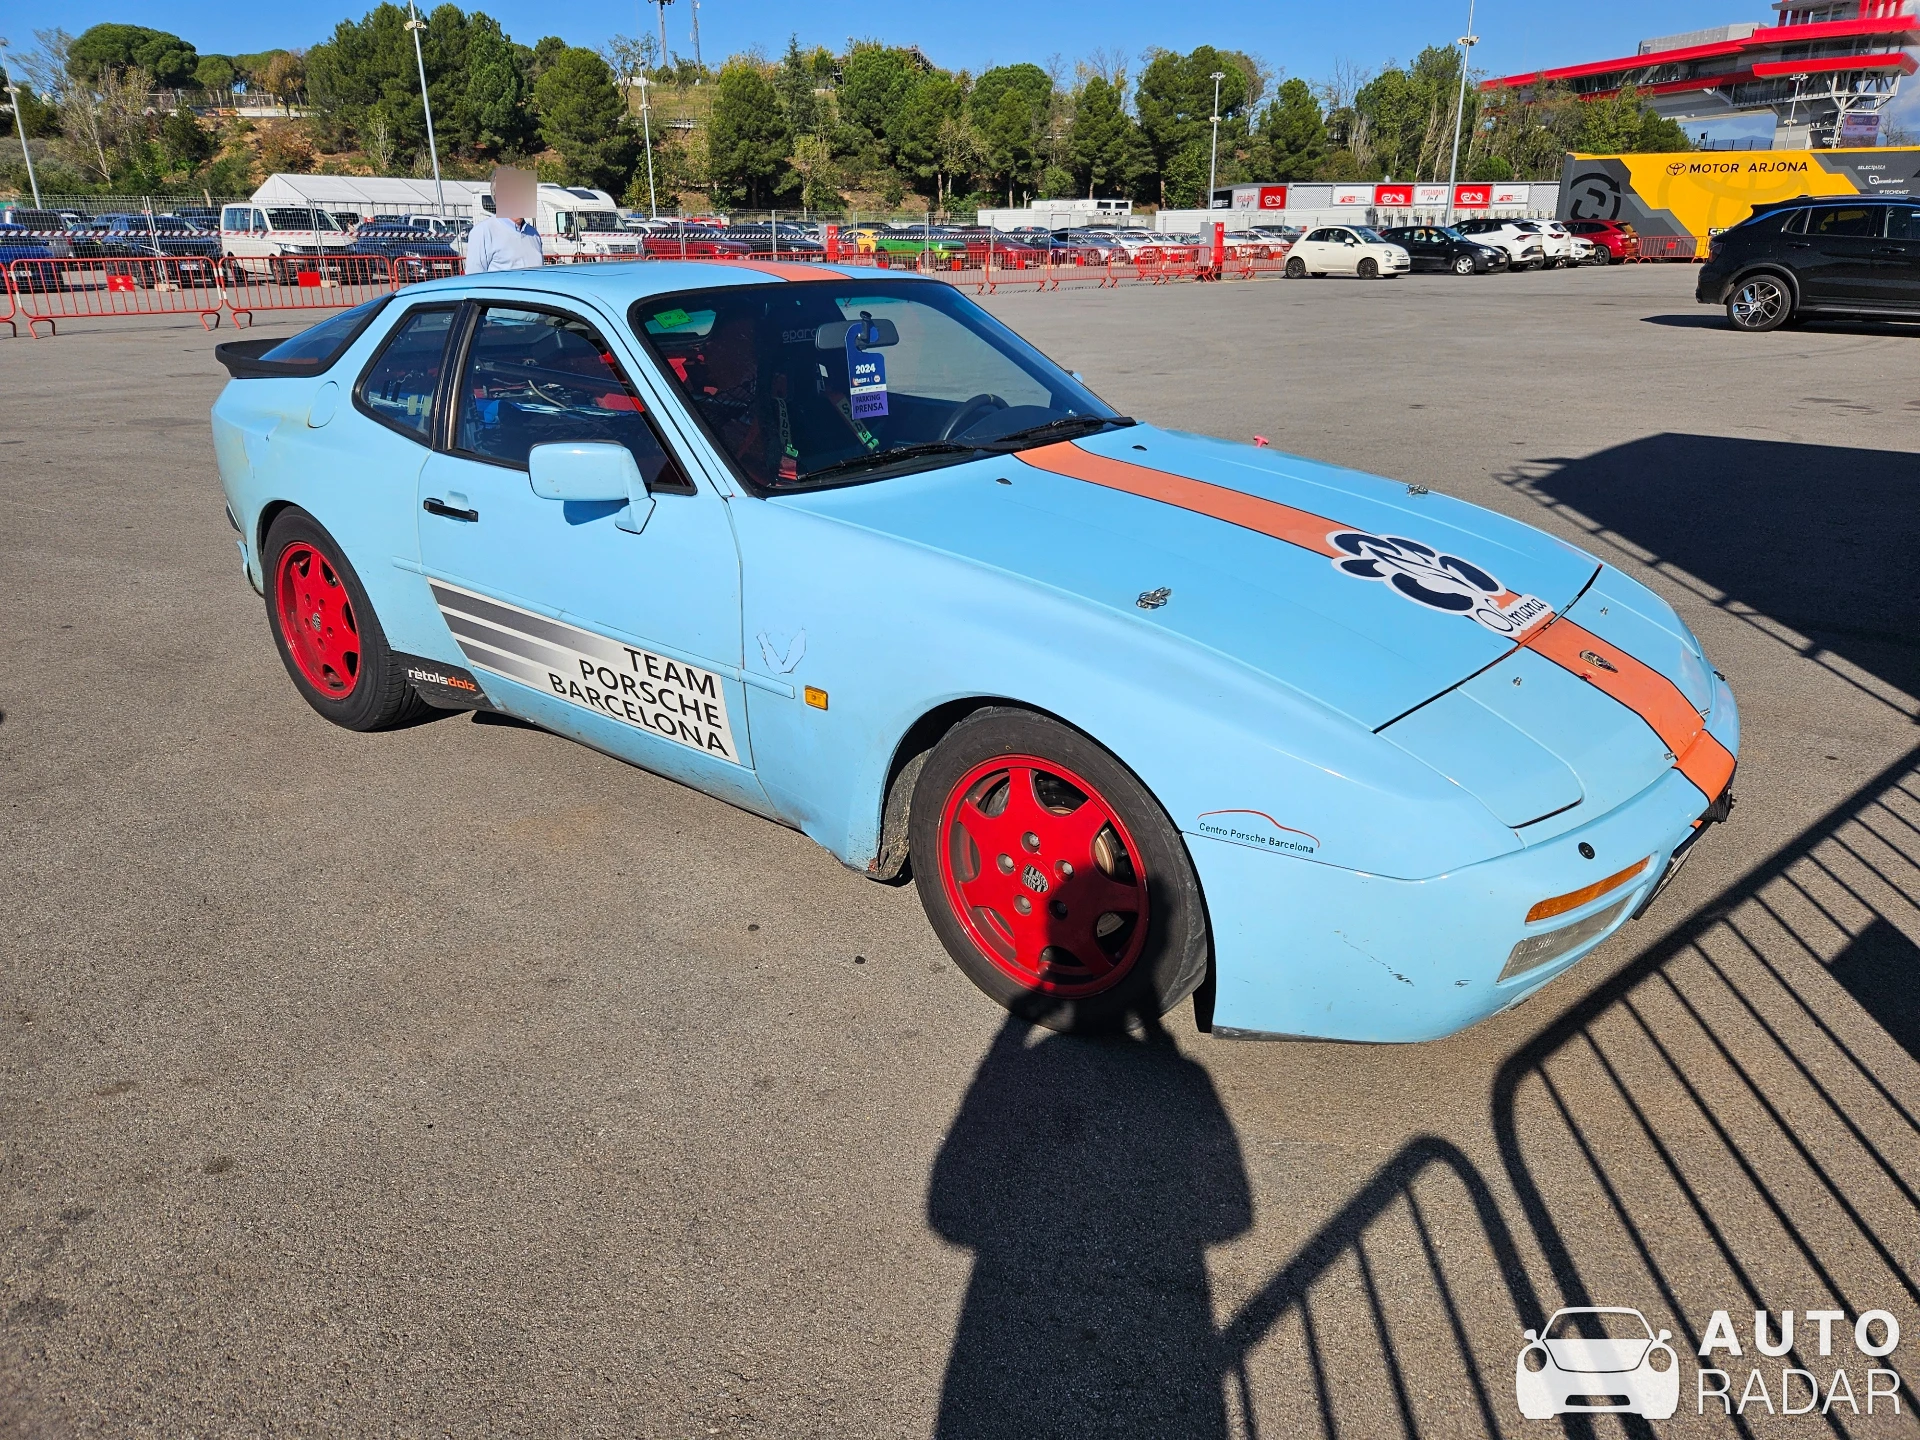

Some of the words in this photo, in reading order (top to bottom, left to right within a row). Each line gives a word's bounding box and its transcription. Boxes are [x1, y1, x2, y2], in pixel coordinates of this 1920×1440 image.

[1689, 163, 1740, 174] MOTOR
[1748, 161, 1809, 173] ARJONA
[855, 363, 876, 375] 2024
[855, 393, 881, 404] PARKING
[855, 402, 884, 414] PRENSA
[623, 647, 716, 699] TEAM
[579, 659, 722, 729] PORSCHE
[548, 673, 730, 757] BARCELONA
[1199, 823, 1228, 836] Centro
[1230, 829, 1266, 844] Porsche
[1268, 837, 1314, 854] Barcelona
